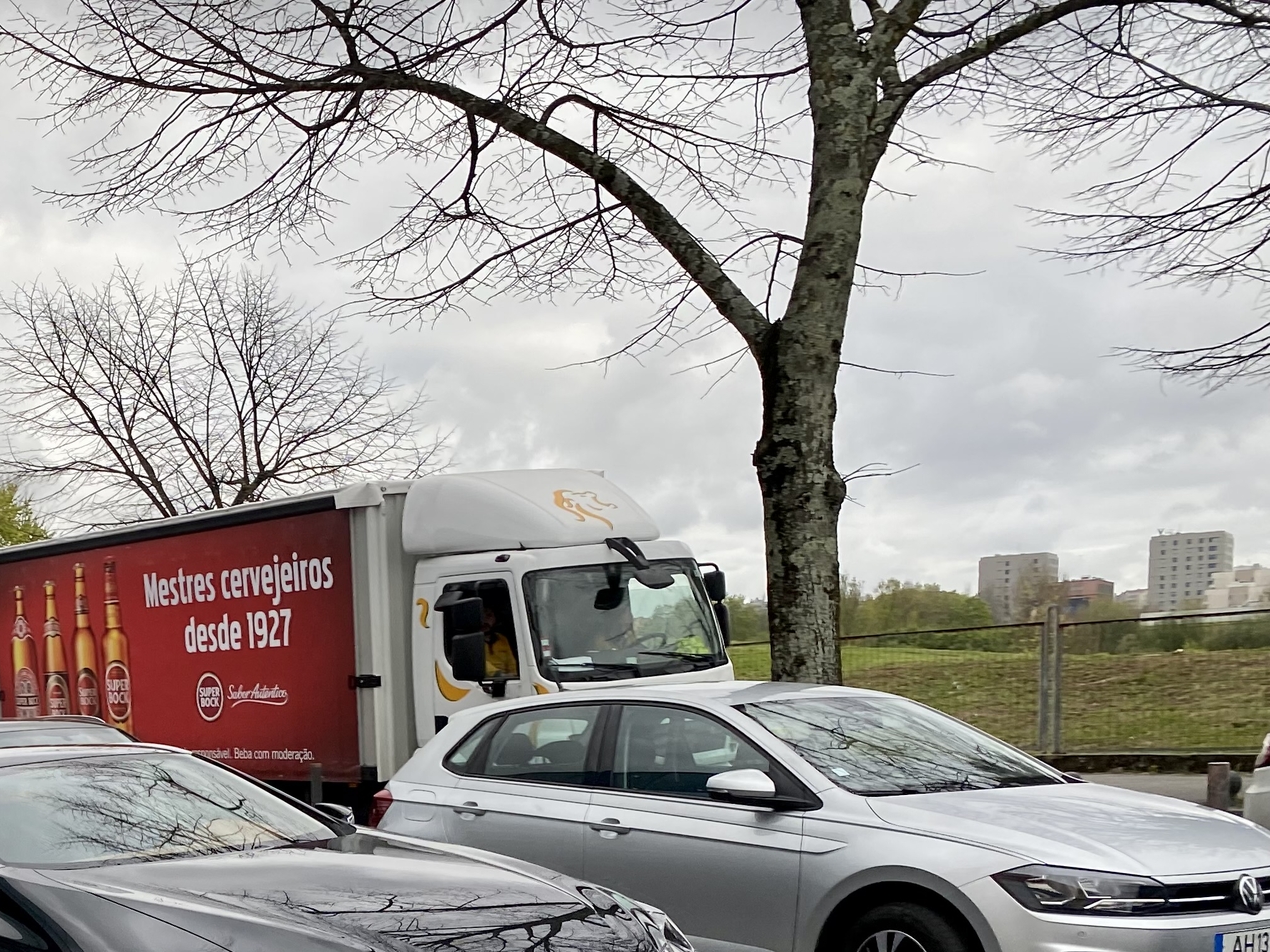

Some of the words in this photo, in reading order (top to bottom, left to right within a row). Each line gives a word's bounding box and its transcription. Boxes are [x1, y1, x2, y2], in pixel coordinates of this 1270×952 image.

[143, 567, 216, 608] Mestres
[221, 551, 334, 606] cervejeiros
[184, 613, 242, 653] desde
[246, 608, 292, 649] 1927
[107, 679, 129, 691] SUPER
[199, 686, 220, 698] SUPER
[200, 697, 220, 708] BOCK
[234, 747, 253, 759] Beba
[254, 750, 270, 760] com
[271, 748, 315, 763] moderação.
